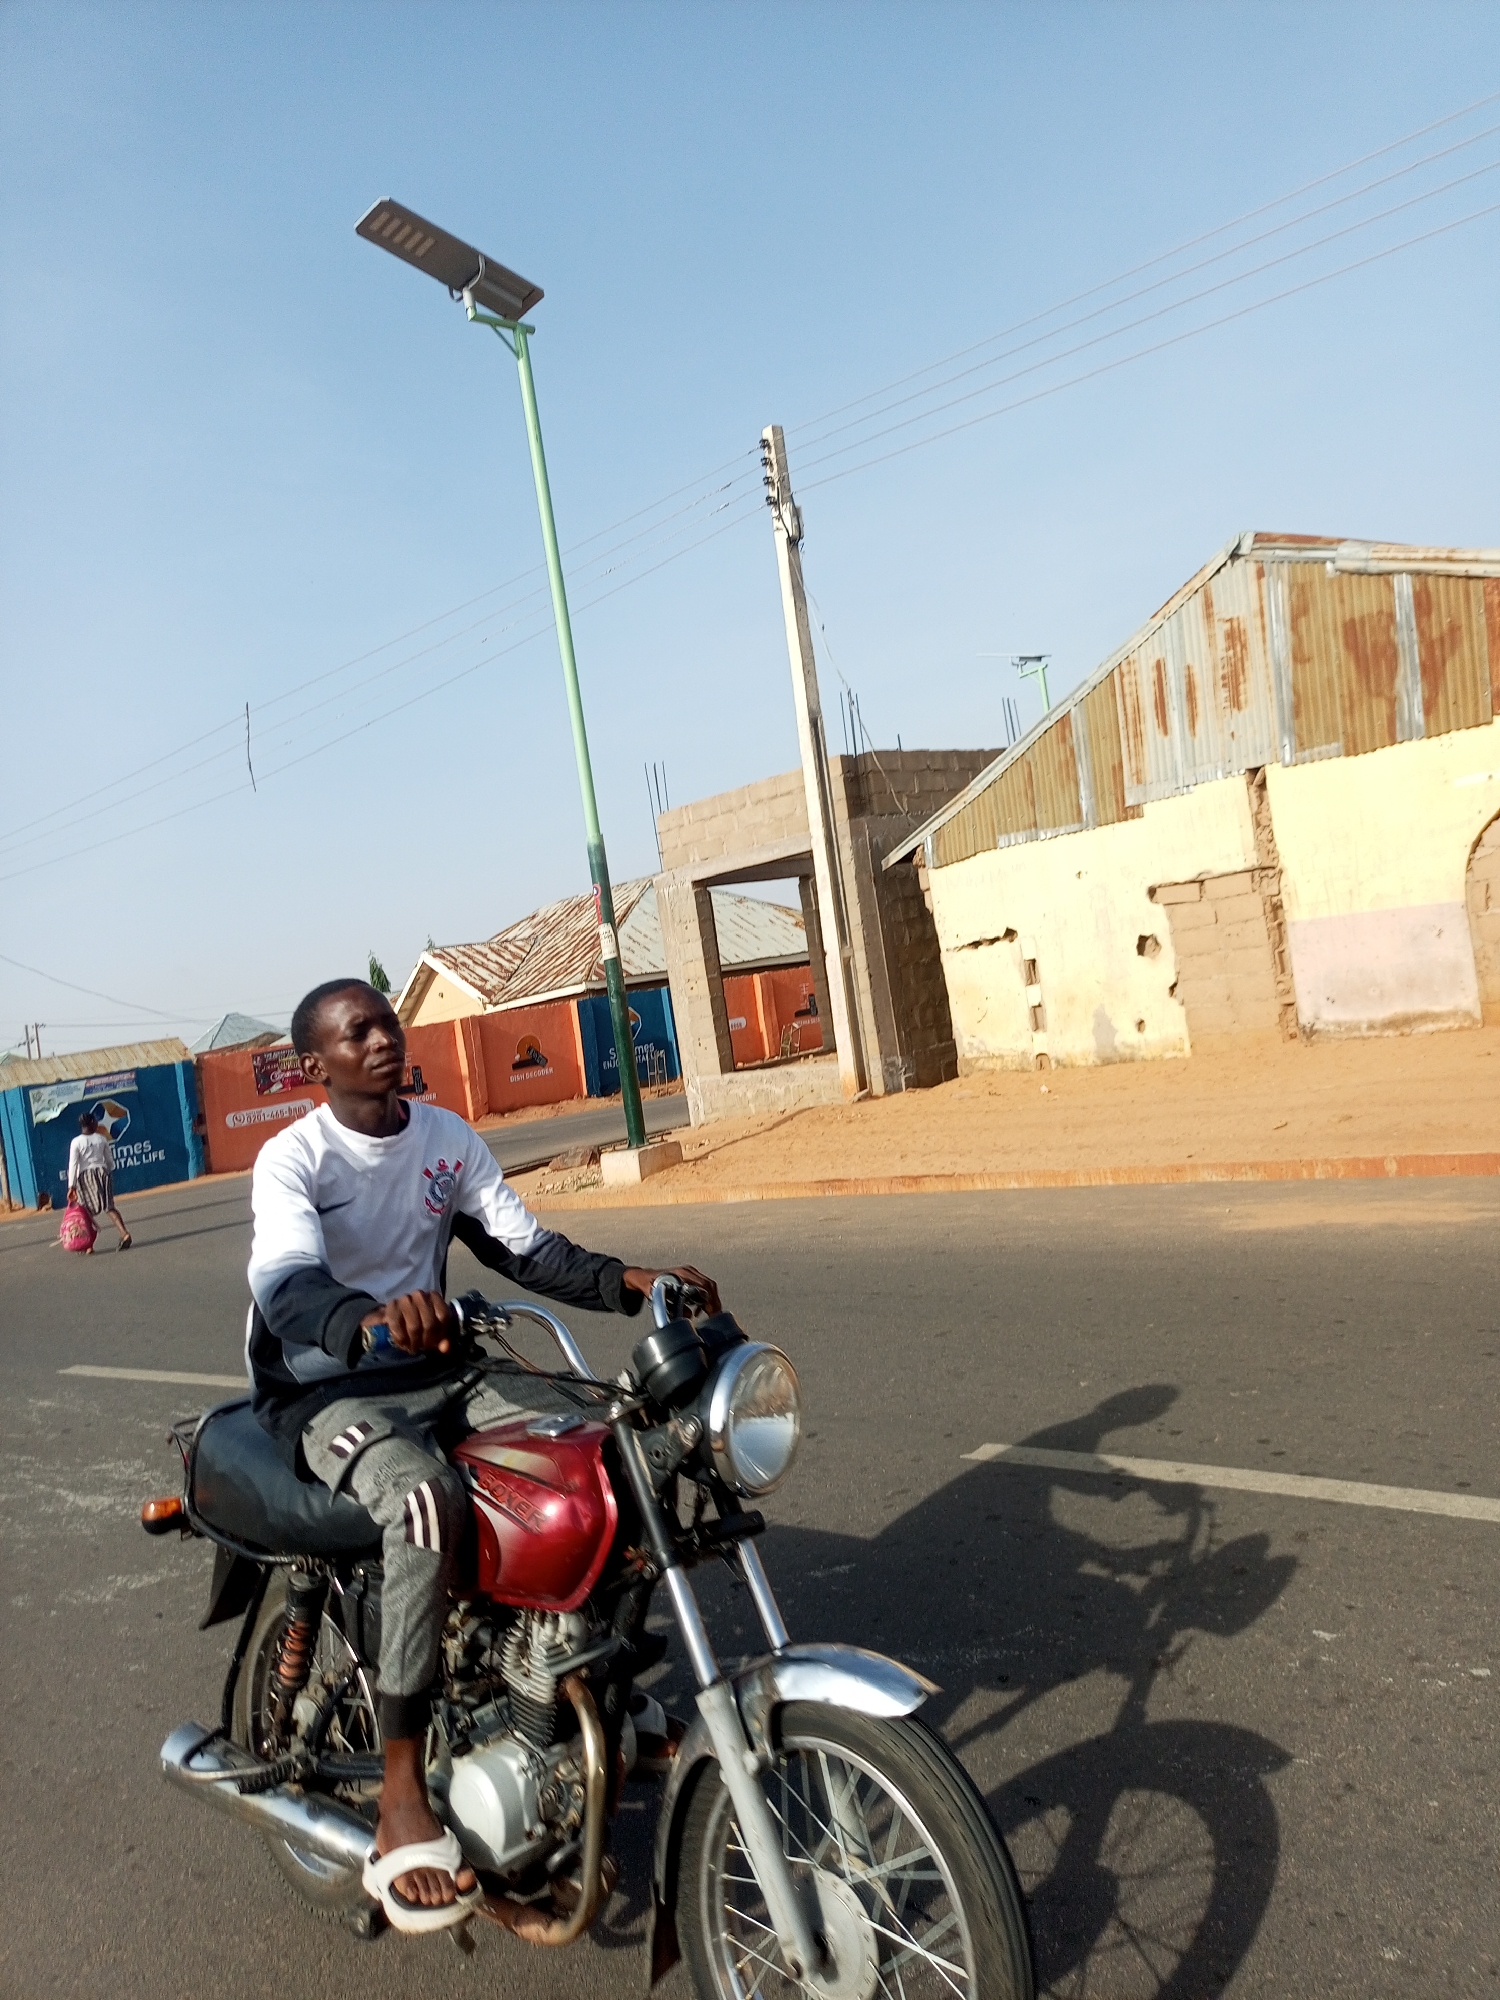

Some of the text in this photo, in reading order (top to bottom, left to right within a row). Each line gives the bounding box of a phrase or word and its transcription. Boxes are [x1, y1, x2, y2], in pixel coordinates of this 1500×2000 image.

[509, 1067, 554, 1083] DISH DECODER
[142, 1149, 166, 1164] LIFE
[478, 1470, 550, 1534] BOXER
